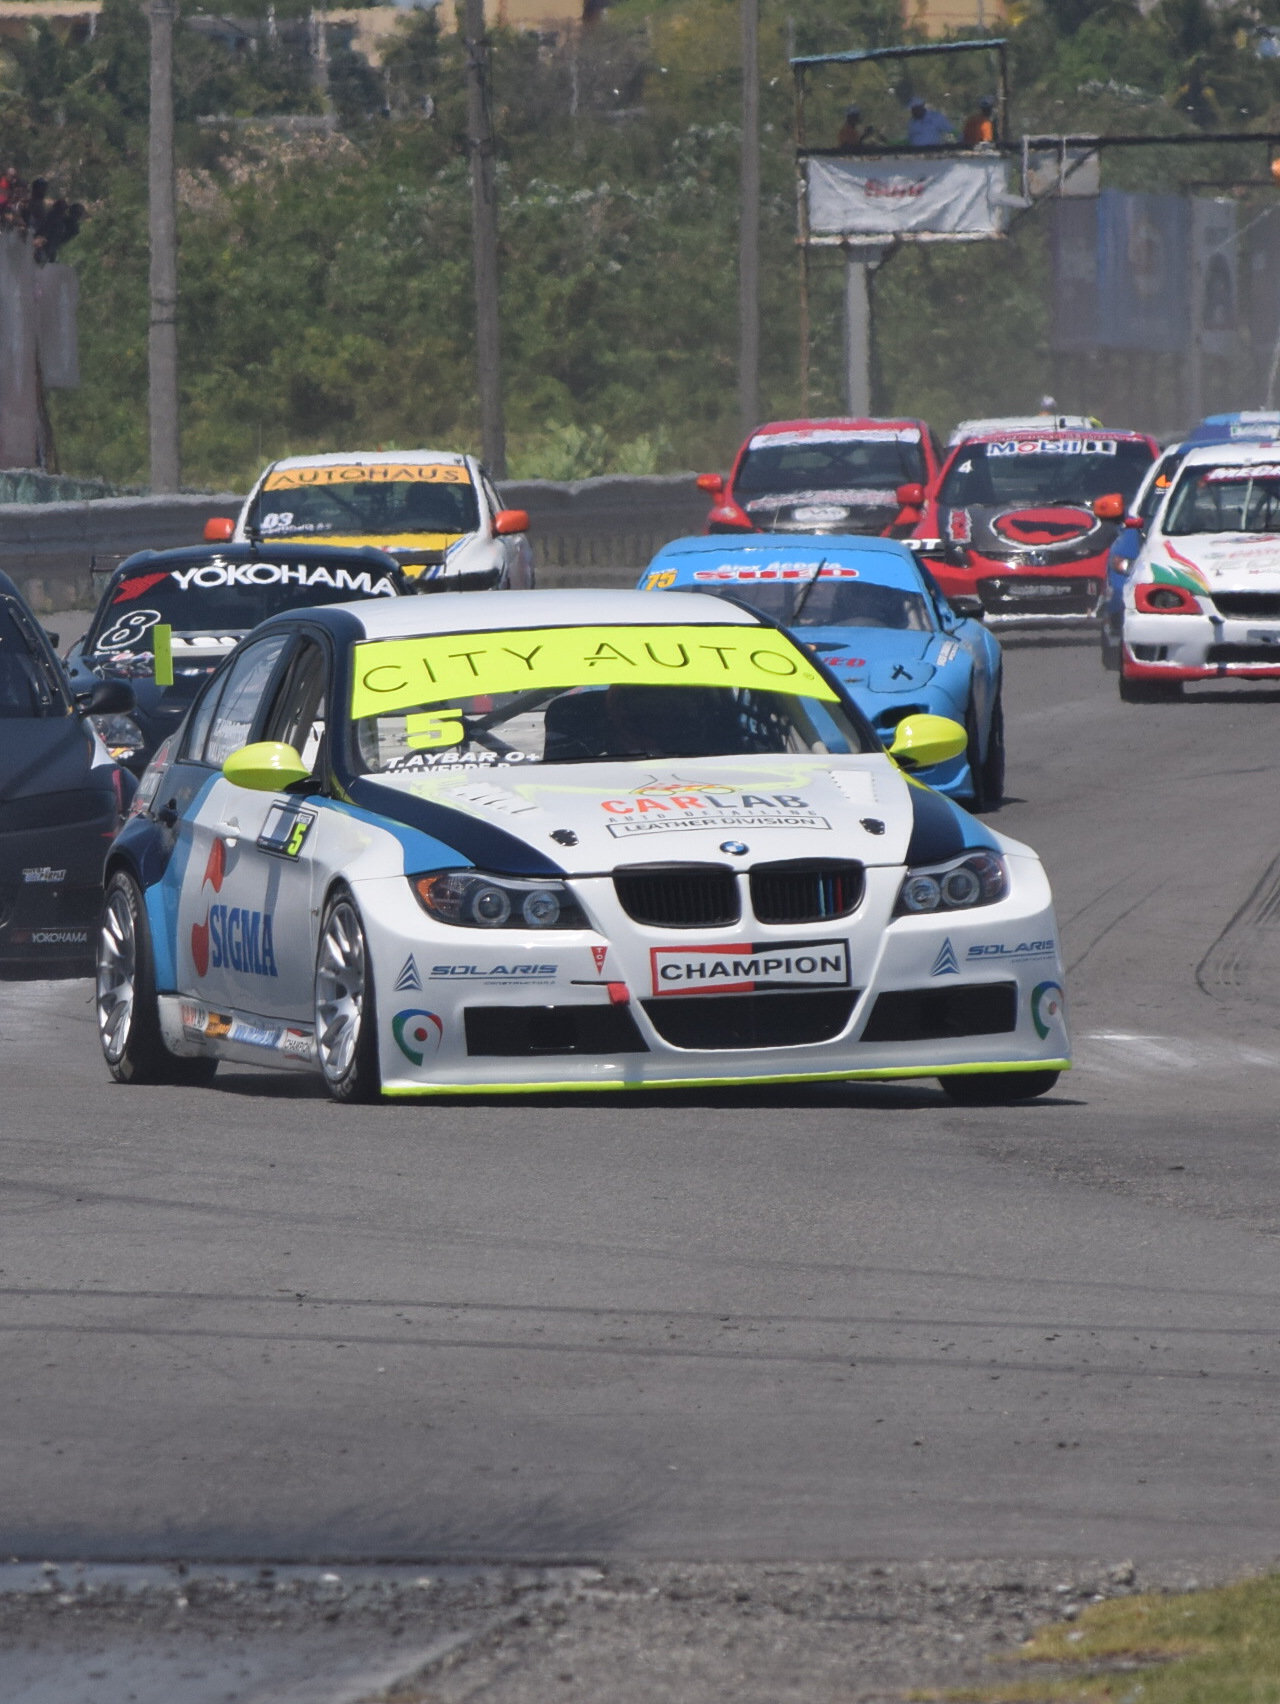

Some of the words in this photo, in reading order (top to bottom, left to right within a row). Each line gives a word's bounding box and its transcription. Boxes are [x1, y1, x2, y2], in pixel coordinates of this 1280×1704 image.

[987, 439, 1082, 456] Mobil
[958, 459, 973, 473] 4
[271, 468, 460, 486] AUTOHAUS
[172, 563, 397, 598] YOKOHAMA
[96, 609, 162, 650] 8
[363, 643, 544, 693] CITY
[583, 642, 798, 676] AUTO
[406, 709, 465, 750] 5
[386, 751, 498, 769] T.AYBAR
[600, 794, 810, 815] CARLAB
[609, 813, 666, 823] AUTO
[623, 818, 716, 832] LEATHER
[720, 817, 817, 826] DIVISION
[287, 822, 308, 856] 5
[32, 932, 88, 942] YOKOHAMA
[209, 904, 279, 977] SIGMA
[967, 940, 1055, 956] SOLARIS
[431, 964, 559, 976] SOLARIS
[660, 955, 842, 981] CHAMPION
